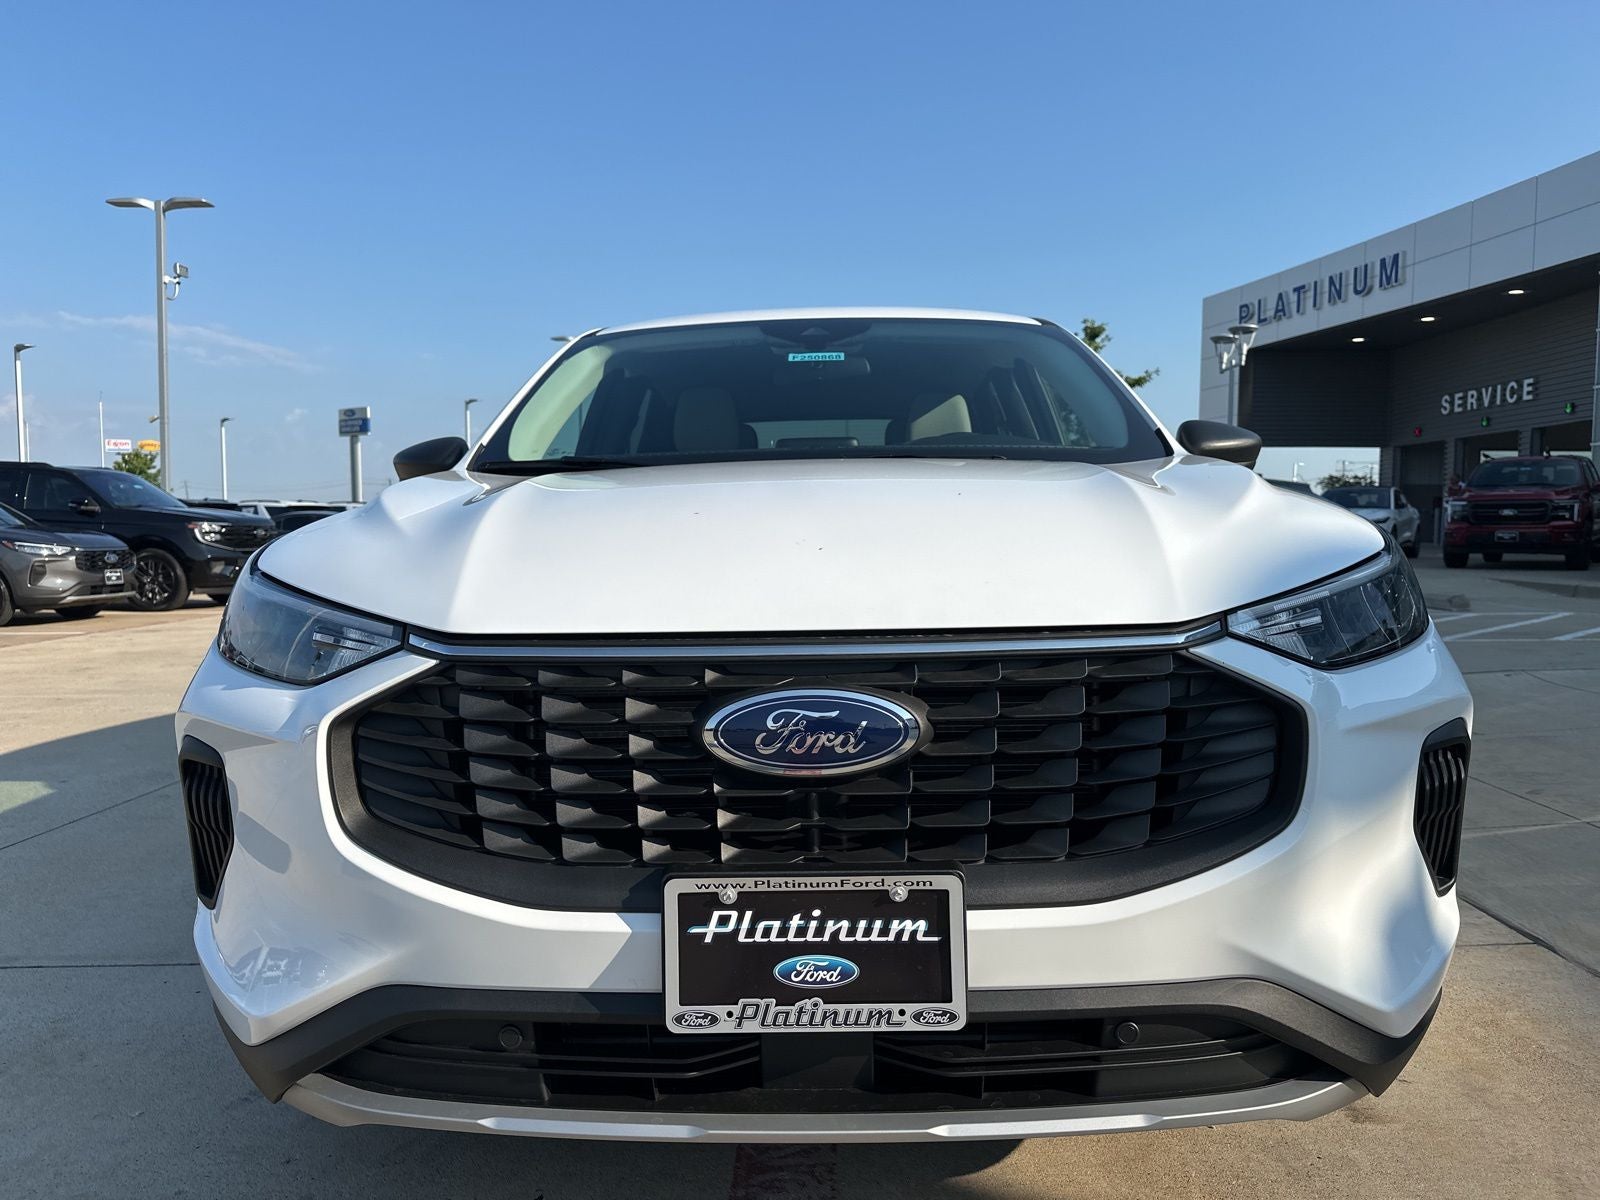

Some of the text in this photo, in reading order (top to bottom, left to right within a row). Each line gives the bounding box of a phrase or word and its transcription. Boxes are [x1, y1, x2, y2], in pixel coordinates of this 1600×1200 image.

[1238, 252, 1402, 325] PLATINUM
[1440, 378, 1536, 416] SERVICE
[755, 708, 867, 755] Ford
[694, 878, 934, 891] www.PlatinumFord.com
[687, 909, 942, 943] Platinum
[791, 961, 842, 983] Ford
[681, 1013, 711, 1026] Ford
[728, 999, 906, 1030] Platinum
[920, 1009, 950, 1024] Ford
